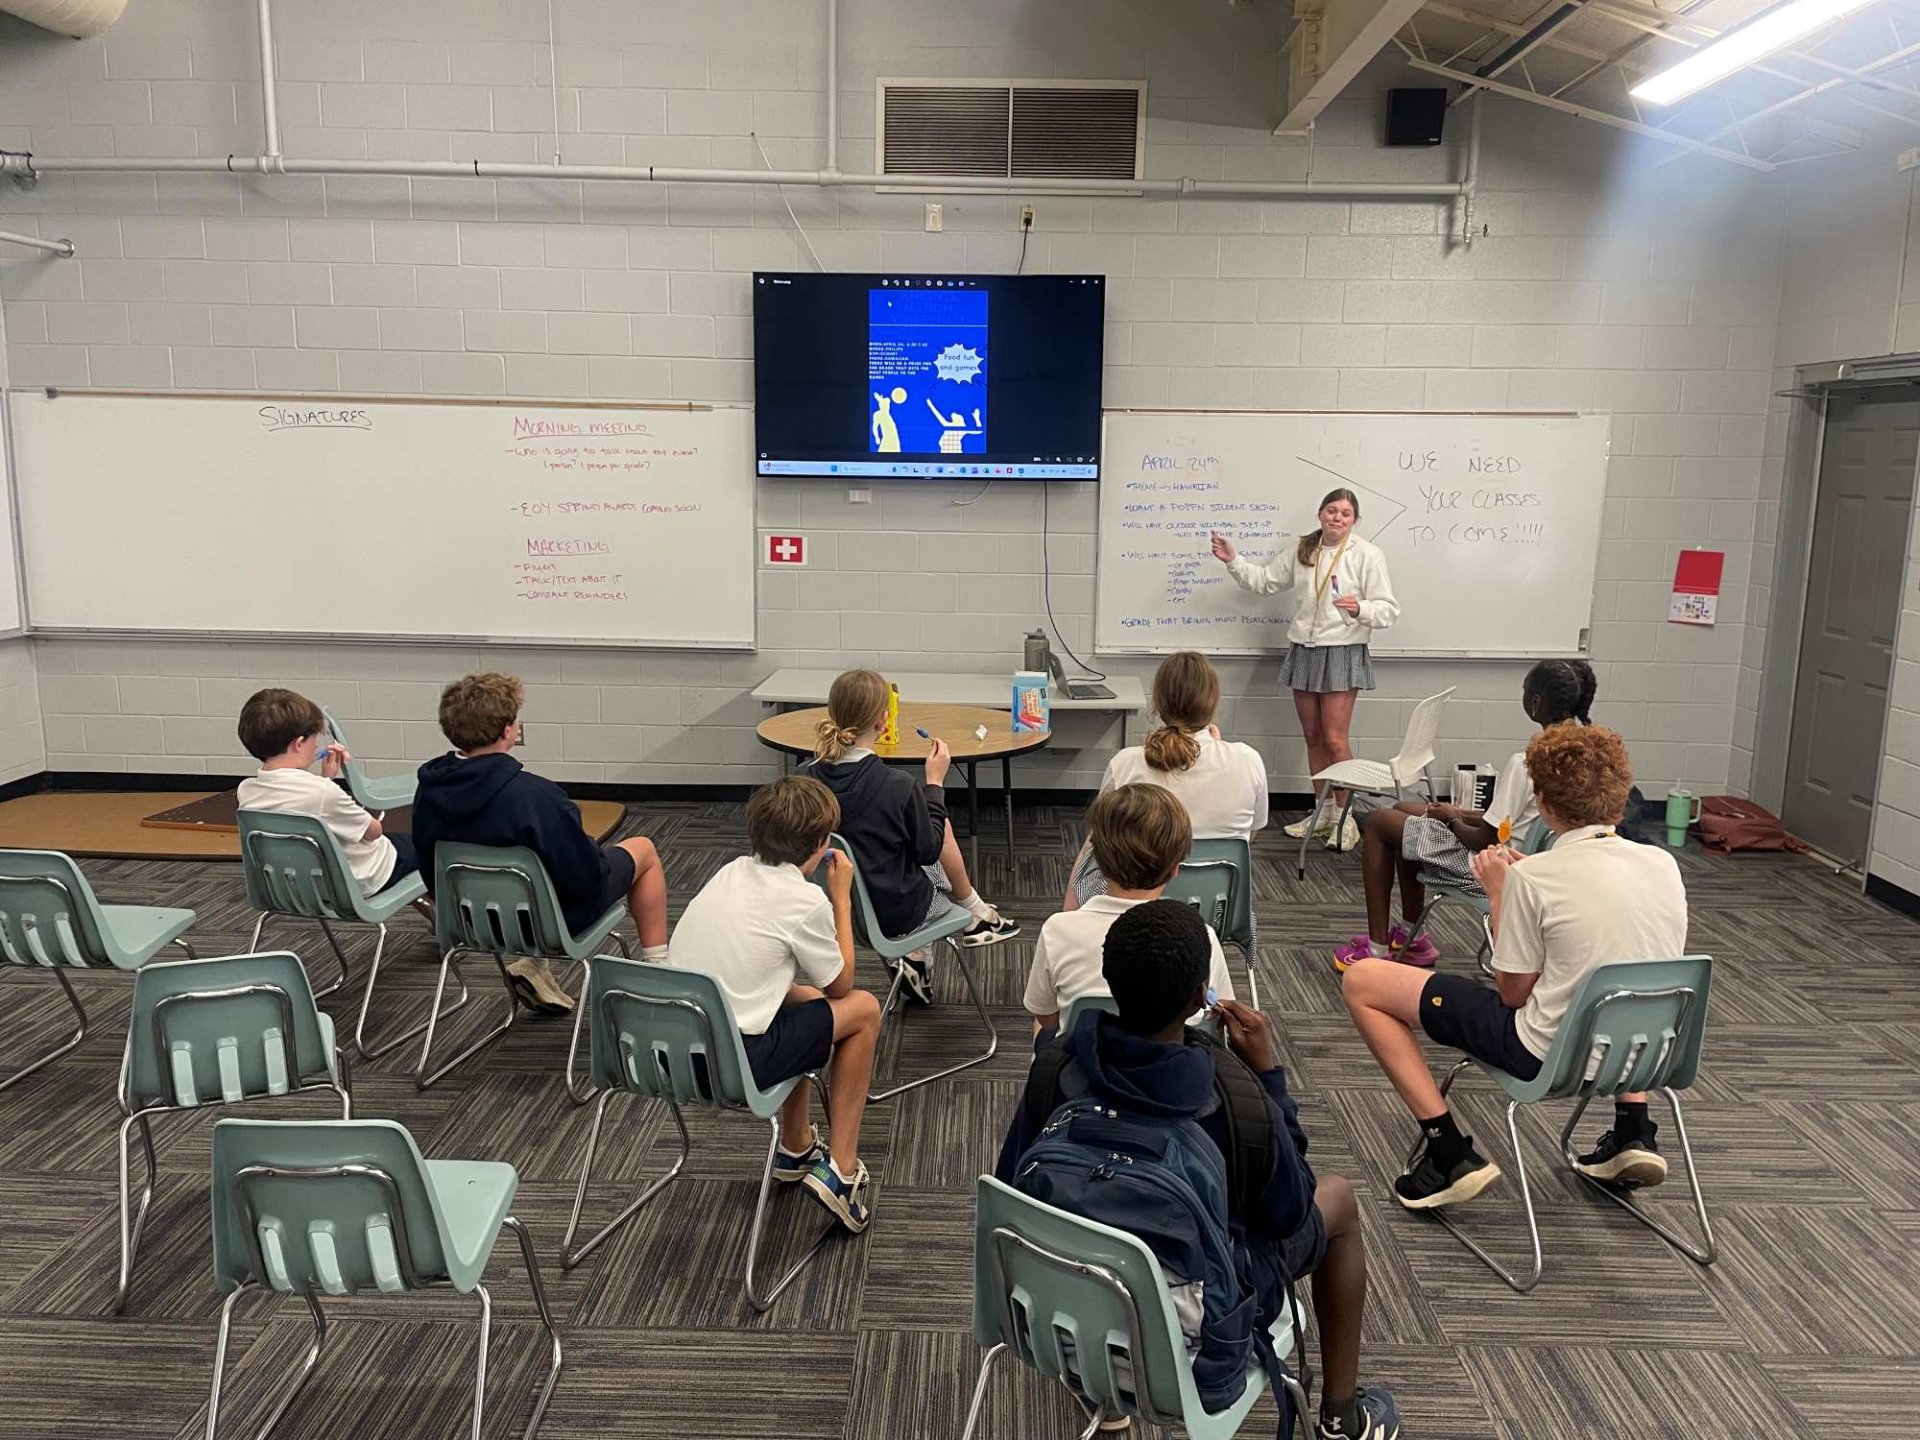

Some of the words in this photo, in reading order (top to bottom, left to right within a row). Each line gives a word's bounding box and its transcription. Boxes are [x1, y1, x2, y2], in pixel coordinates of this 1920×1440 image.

[259, 405, 373, 427] SIGNATURES
[513, 416, 582, 436] MORNING
[589, 421, 648, 434] MEETING
[1141, 454, 1183, 471] APRIL
[1399, 450, 1442, 473] WE
[1468, 455, 1522, 474] NEED
[1128, 502, 1154, 512] WANT
[1209, 502, 1246, 512] STUDENT
[1471, 488, 1541, 510] CLASSES
[1408, 522, 1436, 546] TO
[527, 536, 610, 555] MARKETING
[612, 574, 623, 584] IT
[1156, 616, 1177, 625] THAT
